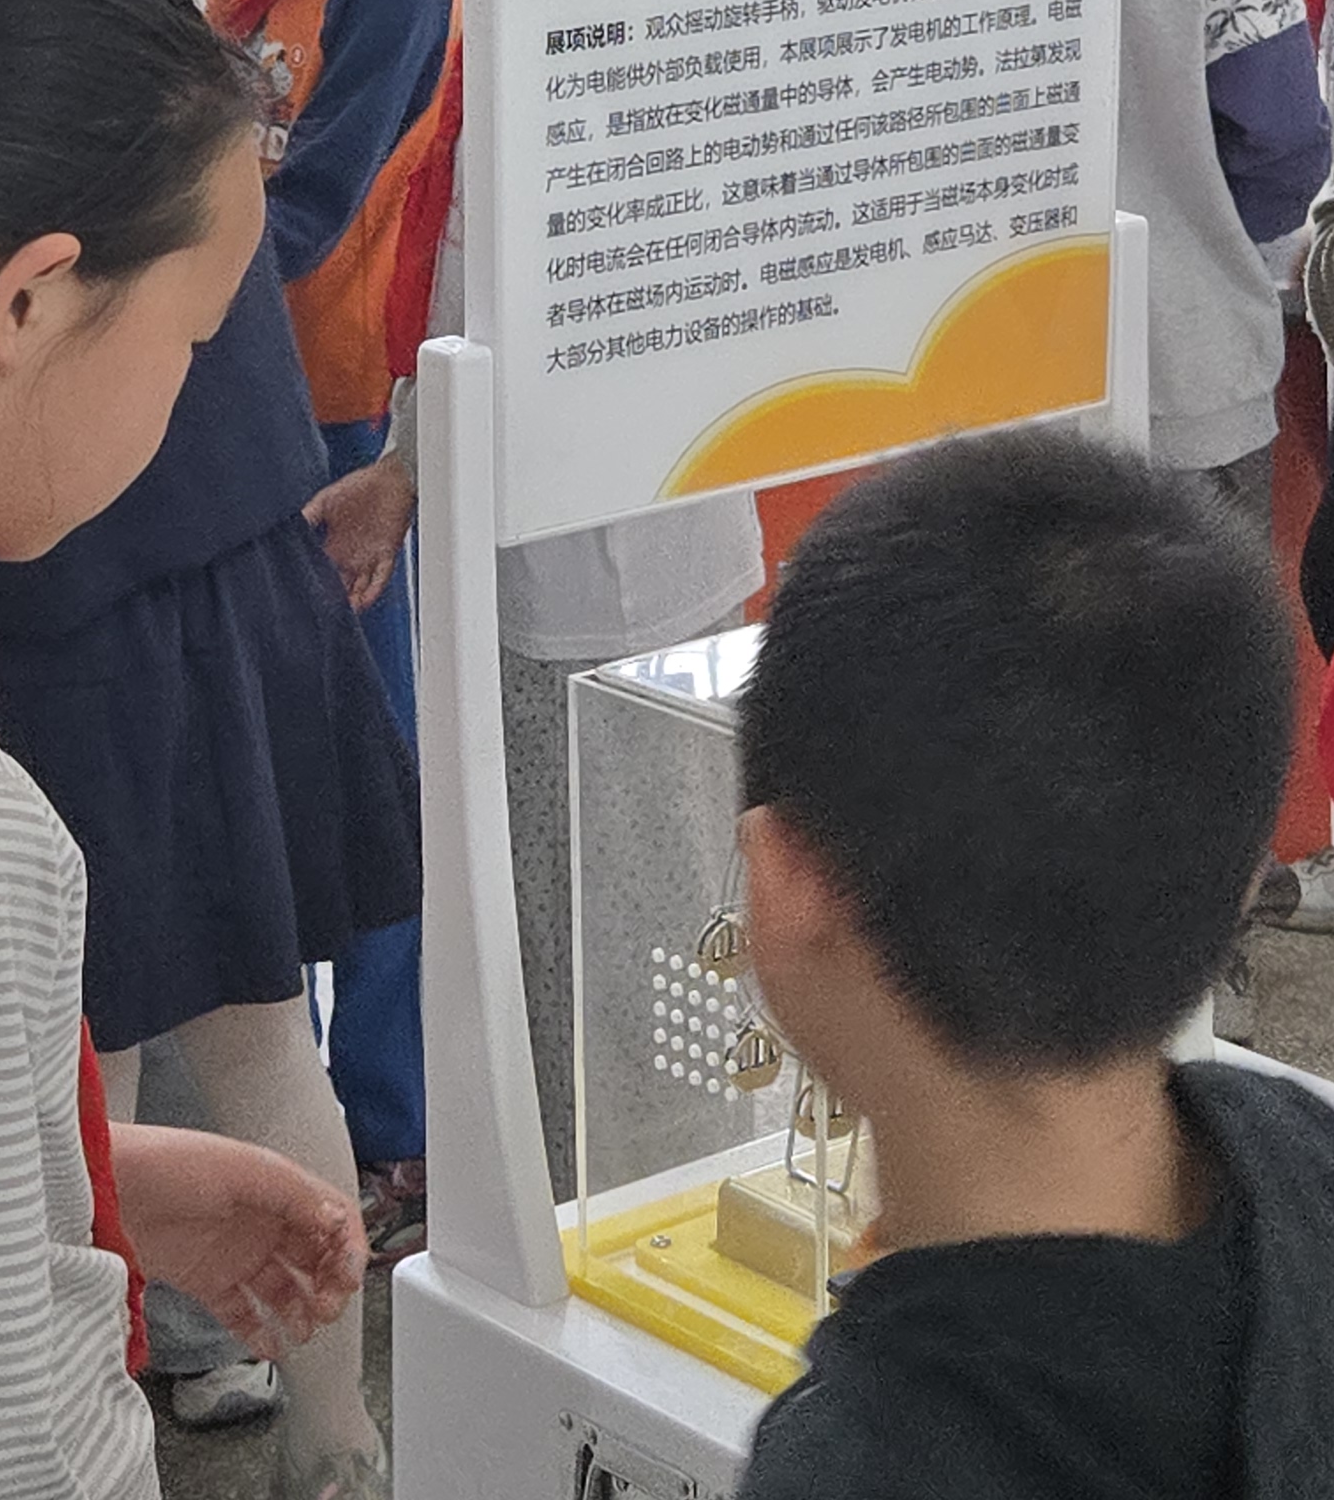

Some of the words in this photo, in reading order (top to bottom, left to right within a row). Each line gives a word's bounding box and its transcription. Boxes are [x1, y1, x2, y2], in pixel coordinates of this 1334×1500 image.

[547, 293, 840, 374] 大部分其他电力设备的操作的基础。
